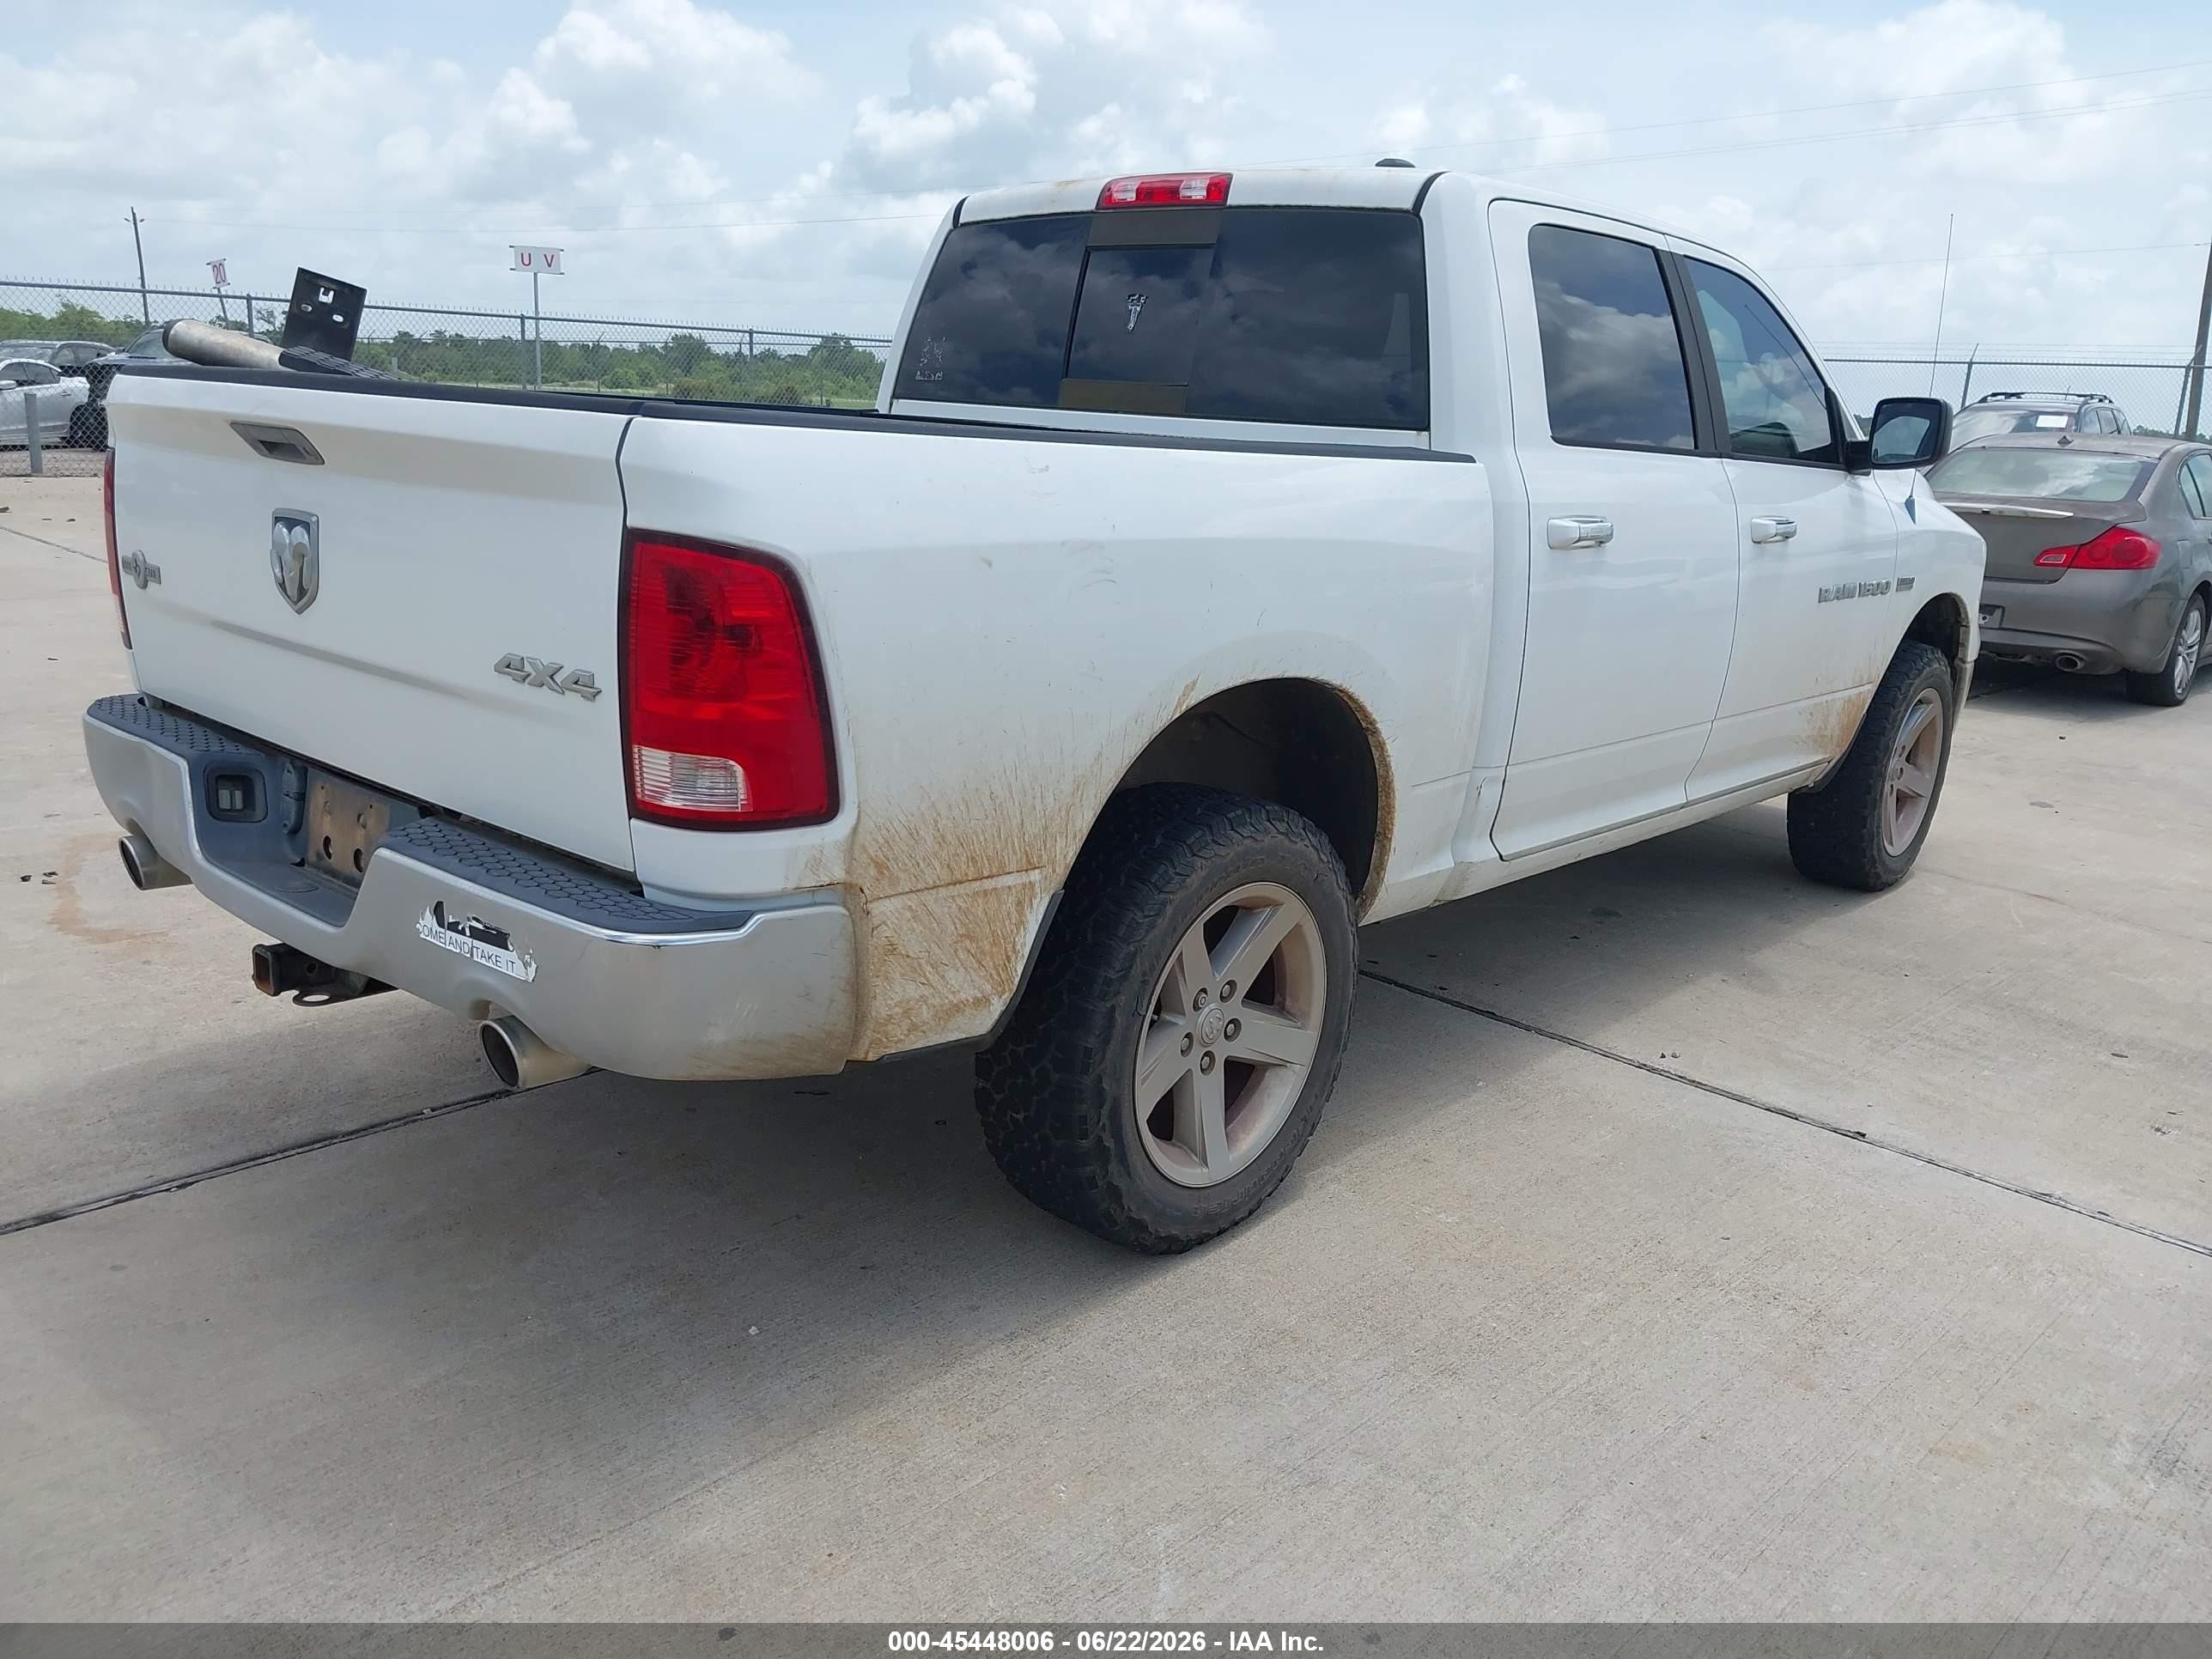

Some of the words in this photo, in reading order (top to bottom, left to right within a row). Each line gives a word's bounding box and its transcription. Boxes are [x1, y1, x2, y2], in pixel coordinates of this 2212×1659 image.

[520, 252, 532, 267] U
[544, 253, 555, 268] V
[212, 263, 227, 284] 20
[1818, 583, 1856, 603] RAM
[447, 934, 470, 955] AND
[473, 945, 502, 969] TAKE
[506, 959, 515, 974] IT
